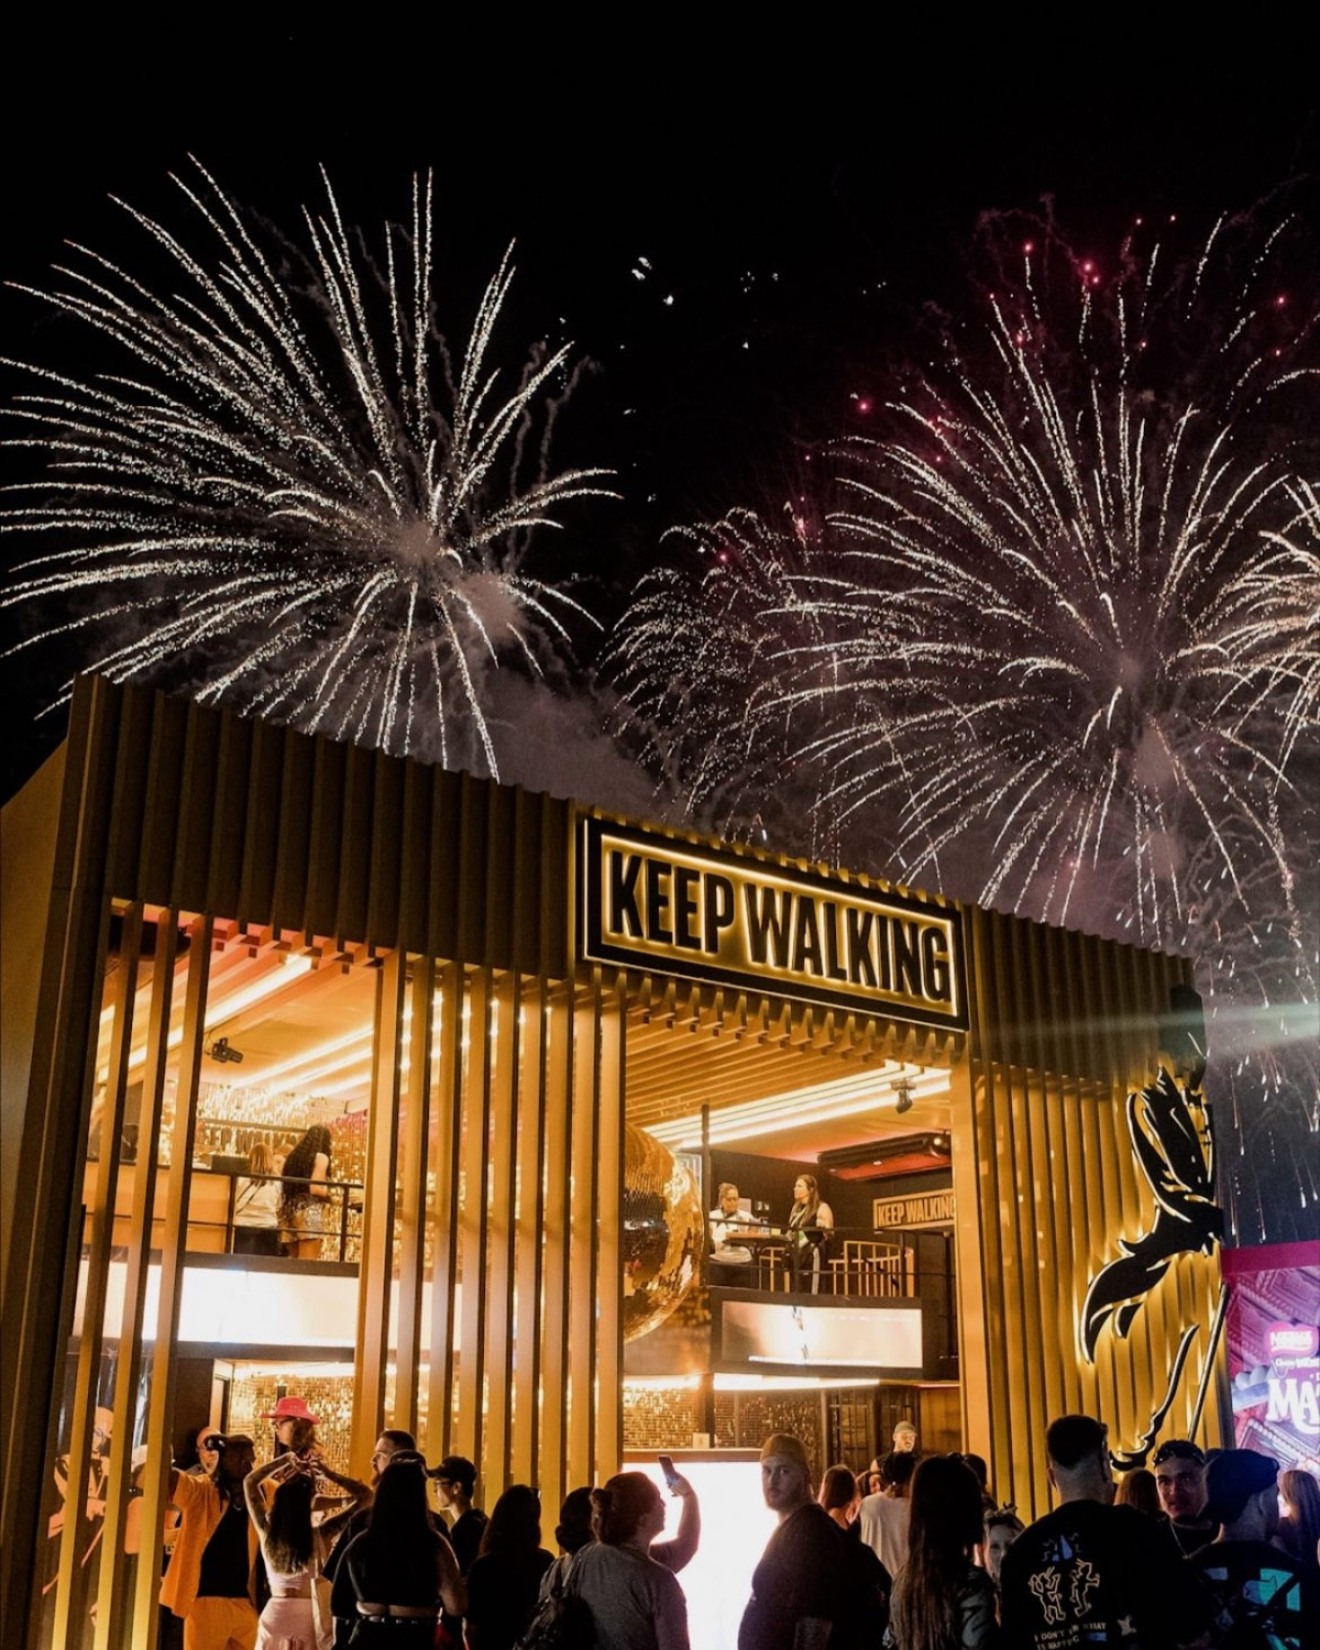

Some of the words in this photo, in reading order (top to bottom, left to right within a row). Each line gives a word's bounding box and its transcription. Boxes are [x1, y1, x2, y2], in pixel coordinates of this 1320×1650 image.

[610, 850, 734, 954] KEEP
[743, 882, 952, 1003] WALKING
[878, 1202, 905, 1227] KEEP
[1266, 1378, 1320, 1435] MA
